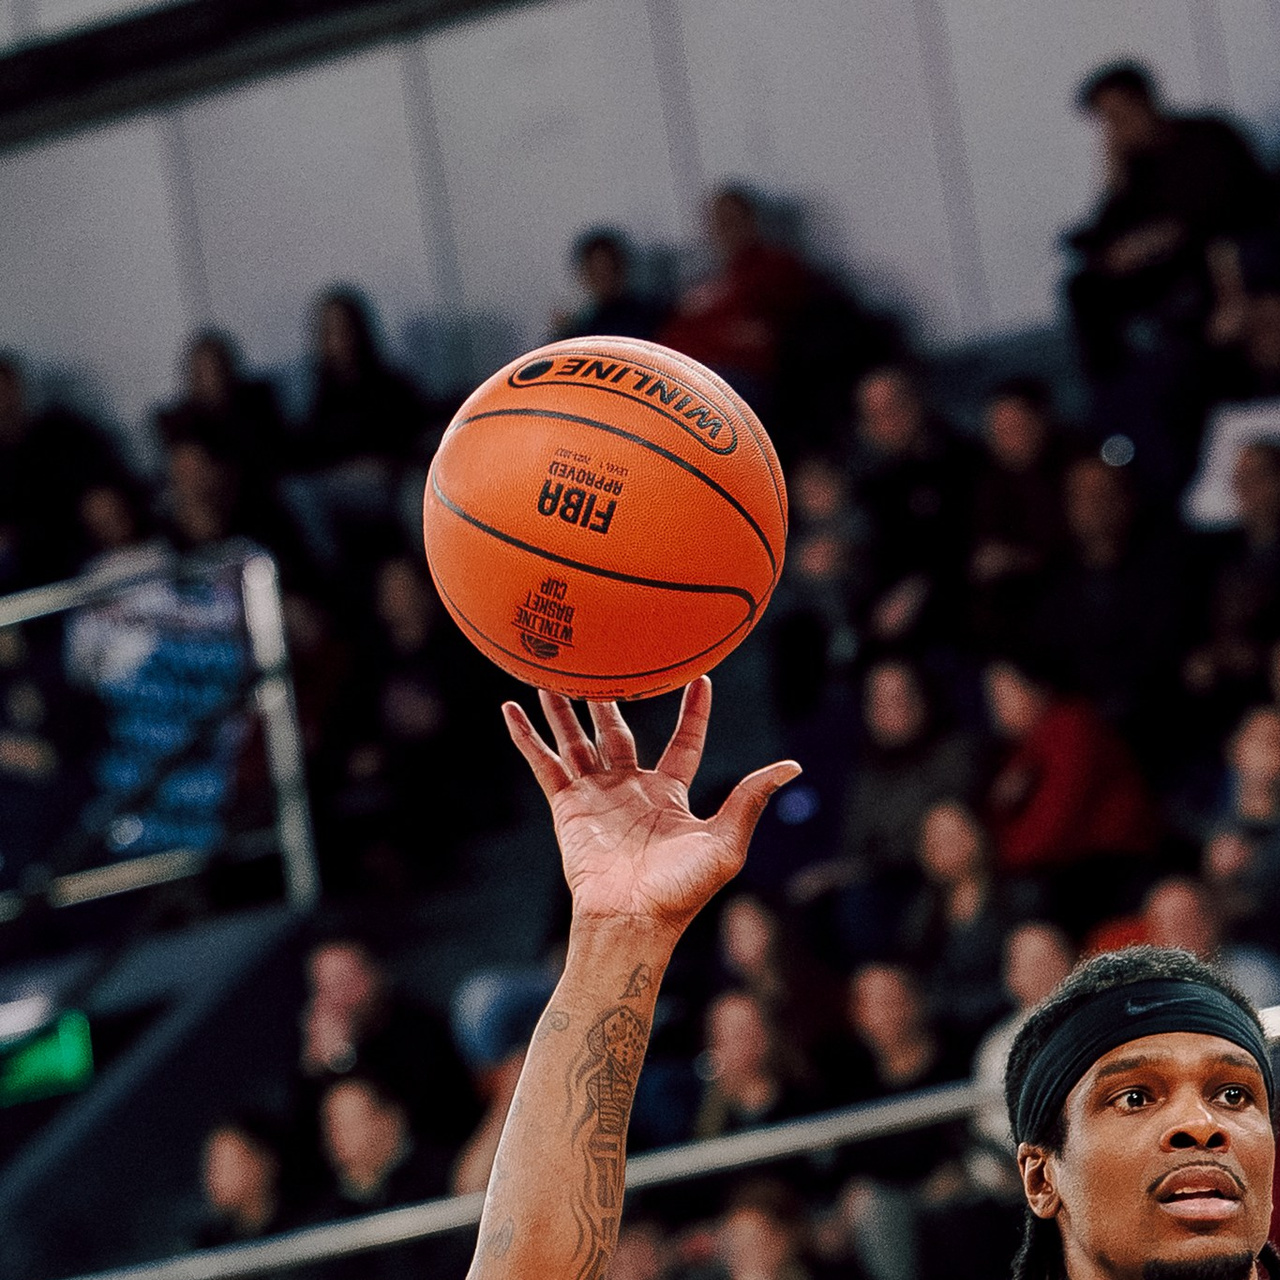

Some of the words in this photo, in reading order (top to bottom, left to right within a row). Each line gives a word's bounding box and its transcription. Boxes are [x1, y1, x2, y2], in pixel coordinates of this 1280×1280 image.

[555, 358, 725, 440] WINLINE
[548, 460, 624, 496] APPROVED
[537, 479, 617, 535] FIBA
[523, 589, 575, 623] BASKET
[540, 577, 568, 601] CUP
[513, 606, 573, 643] WINLINE
